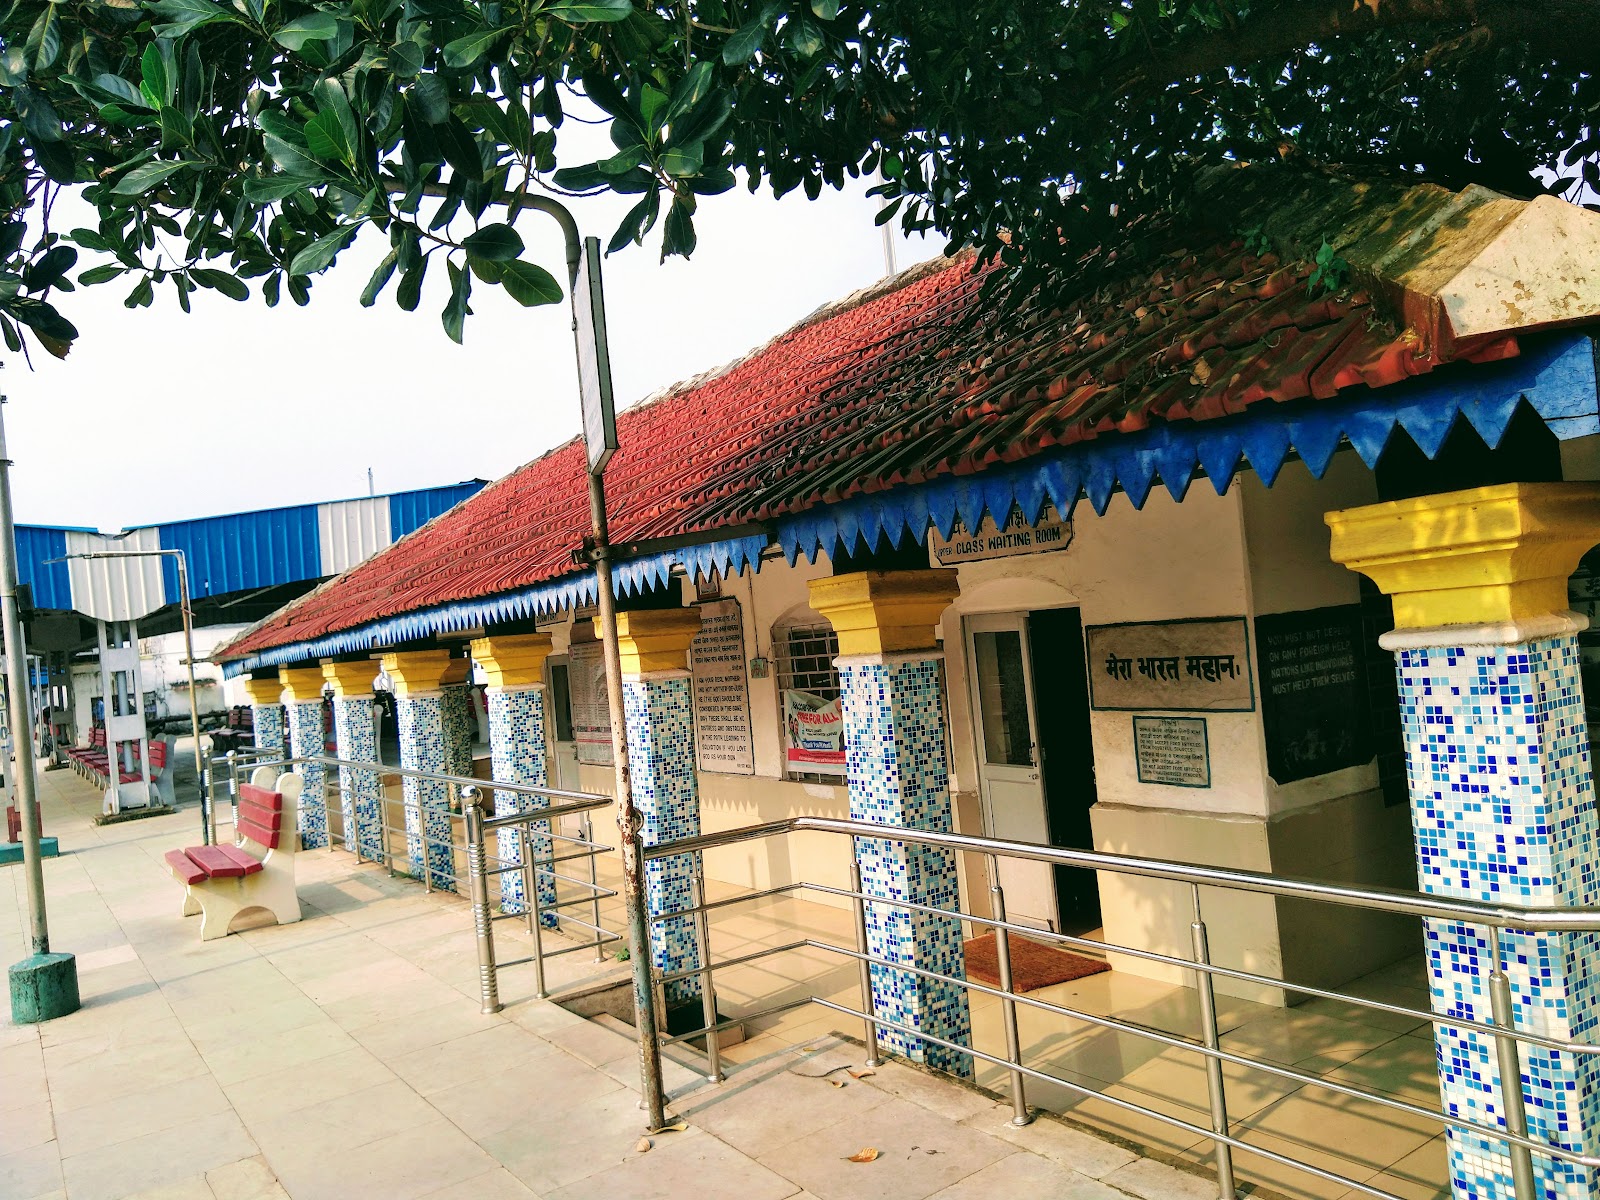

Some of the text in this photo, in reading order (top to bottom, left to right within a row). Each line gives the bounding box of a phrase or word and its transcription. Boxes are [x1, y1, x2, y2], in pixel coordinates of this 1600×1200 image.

[956, 540, 984, 555] CLASS
[988, 531, 1031, 550] WAITING
[1035, 526, 1061, 544] ROOM
[1267, 636, 1281, 646] YOU
[1284, 632, 1302, 643] MUST
[1306, 629, 1320, 640] NOT
[1268, 652, 1280, 662] ON
[1281, 649, 1297, 660] ANY
[1299, 643, 1330, 658] FOREIGN
[1105, 652, 1133, 681] मेरा
[1137, 656, 1180, 682] भारत
[1271, 655, 1354, 679] NATIONS LIKE INDIVIDUALS
[704, 676, 714, 684] YOUR
[1272, 682, 1291, 695] MUST
[1292, 679, 1311, 692] HELP
[809, 712, 822, 725] FOR
[822, 712, 839, 724] ALL
[723, 734, 739, 742] LEADING
[702, 743, 721, 751] SALVATION
